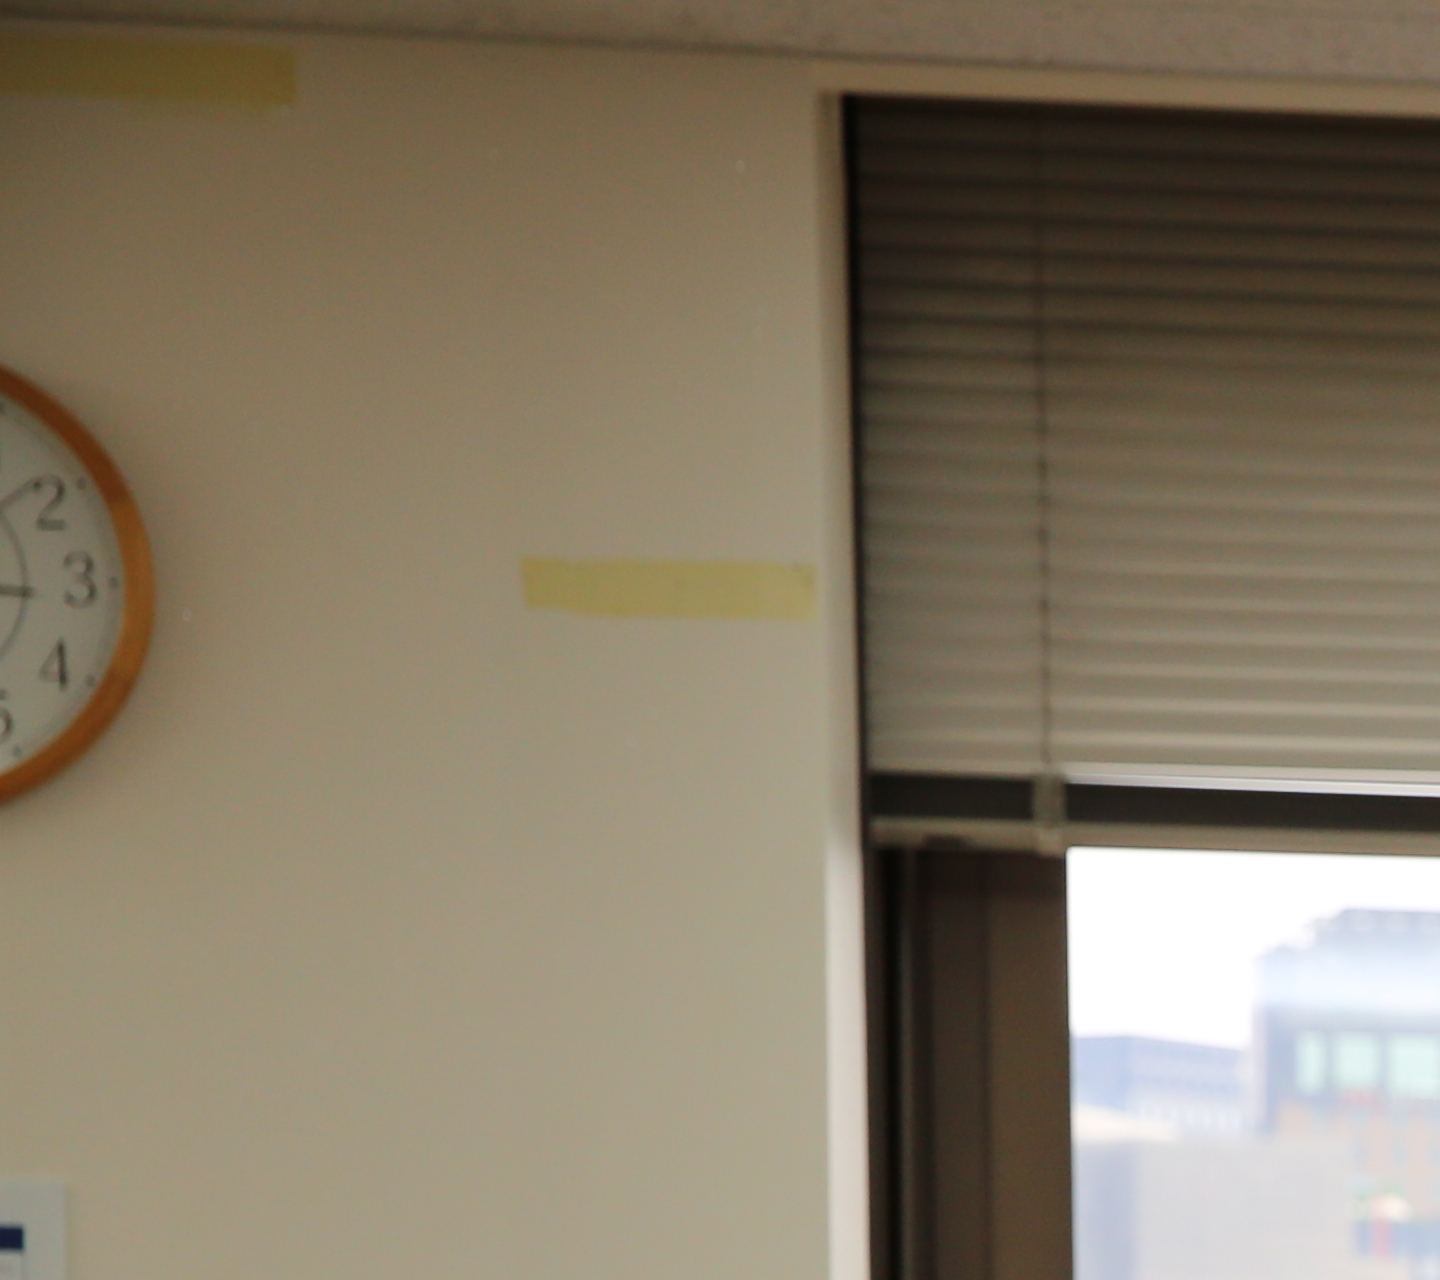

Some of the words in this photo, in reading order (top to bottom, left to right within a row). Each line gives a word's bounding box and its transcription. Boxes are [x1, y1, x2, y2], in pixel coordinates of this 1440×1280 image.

[35, 475, 66, 531] 2
[63, 552, 98, 608] 3
[39, 638, 69, 691] 4
